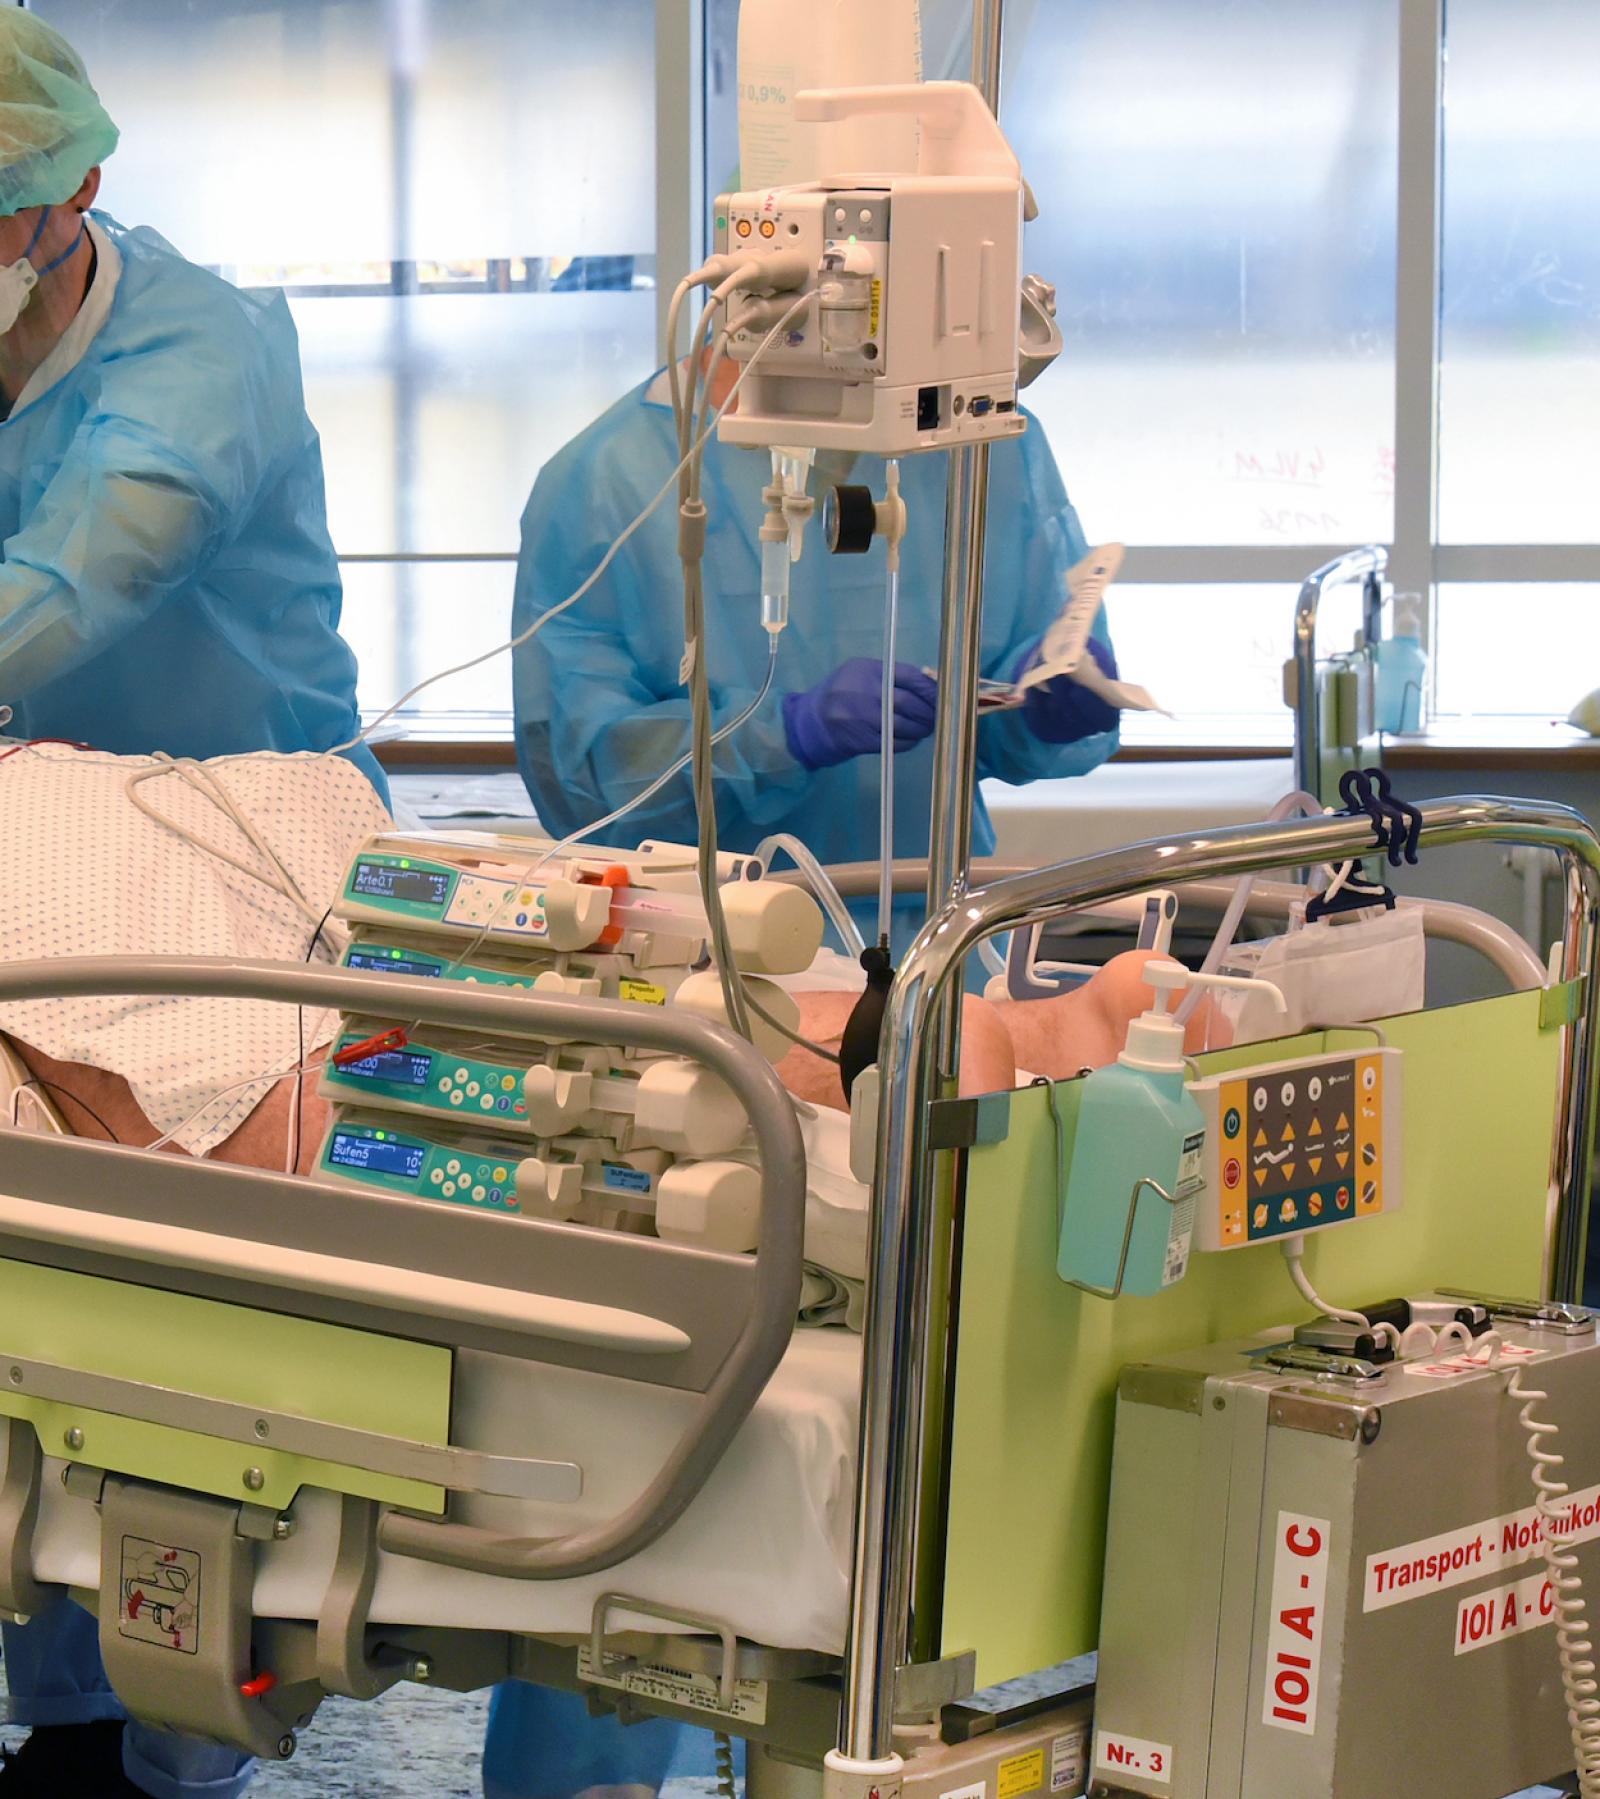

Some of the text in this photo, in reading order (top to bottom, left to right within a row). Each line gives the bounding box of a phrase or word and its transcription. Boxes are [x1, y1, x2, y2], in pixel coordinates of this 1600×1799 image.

[413, 1064, 426, 1077] 10
[333, 1143, 419, 1169] Sufen5 10
[1286, 1524, 1322, 1557] C
[1374, 1535, 1482, 1594] Transport
[1280, 1606, 1316, 1641] A
[1501, 1592, 1518, 1631] A
[1107, 1742, 1140, 1768] Nr.
[1150, 1752, 1163, 1773] 3
